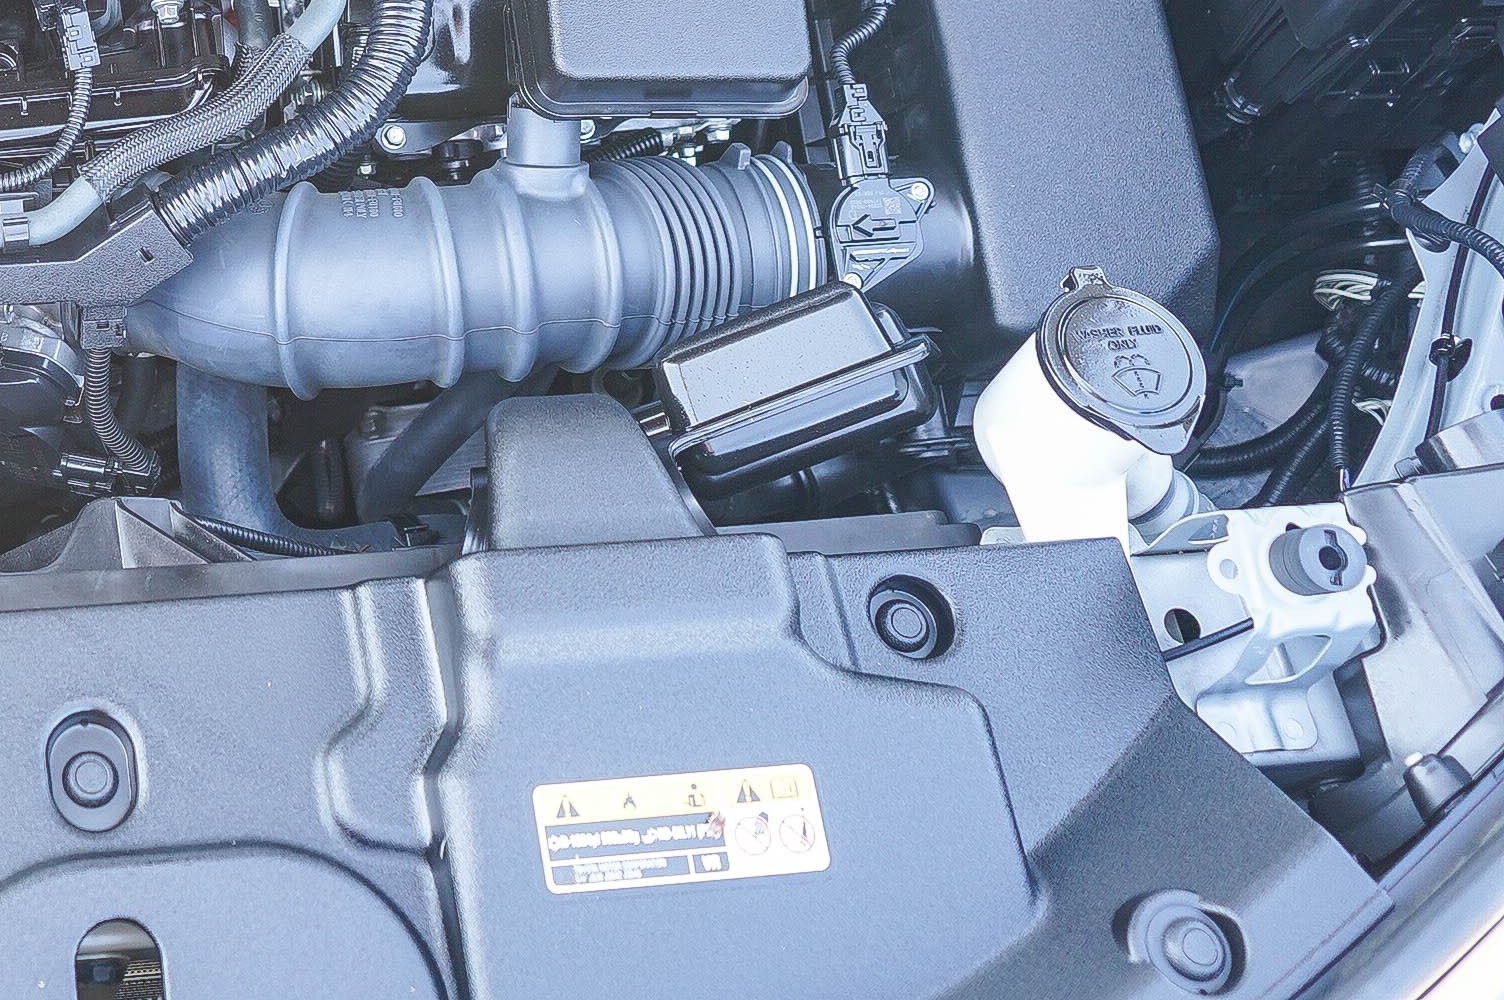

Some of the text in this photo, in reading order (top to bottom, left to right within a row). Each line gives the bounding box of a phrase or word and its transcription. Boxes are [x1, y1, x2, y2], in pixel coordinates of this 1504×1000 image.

[1069, 323, 1164, 343] WASHER FLUID
[1106, 337, 1138, 351] ONLY
